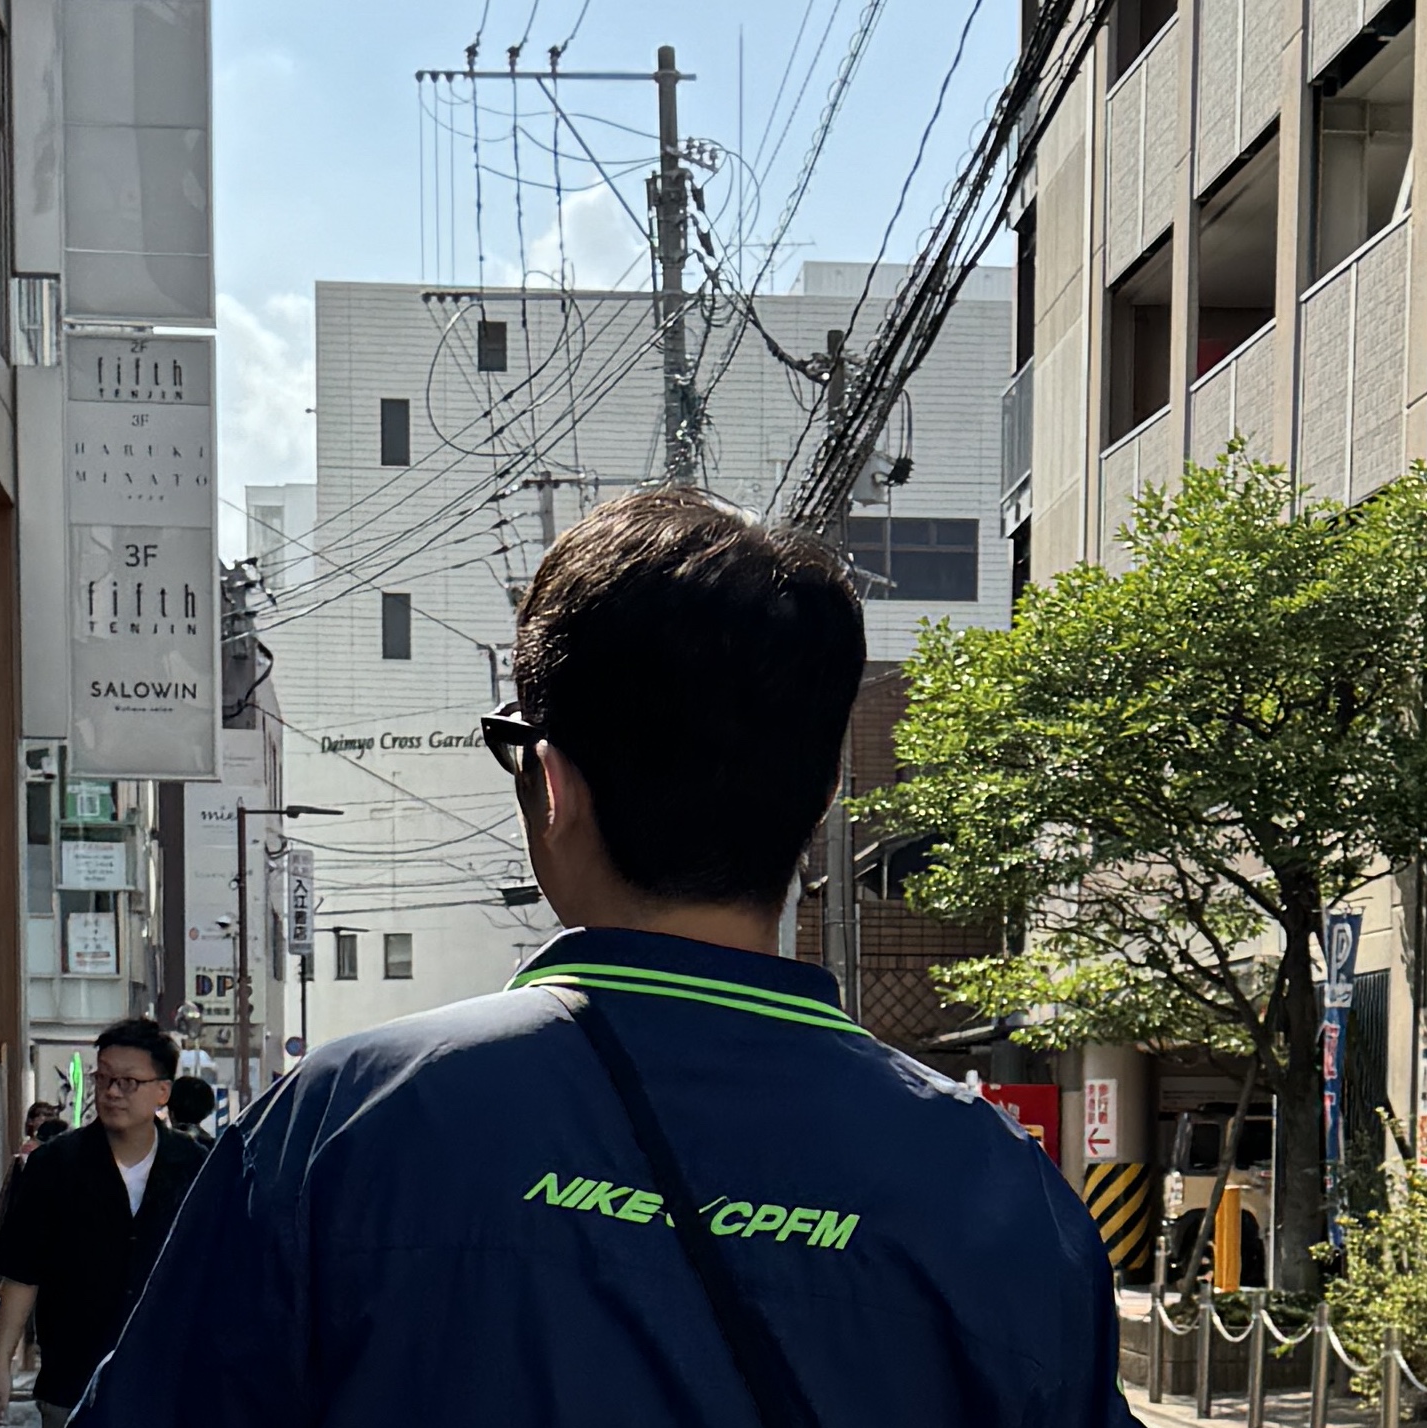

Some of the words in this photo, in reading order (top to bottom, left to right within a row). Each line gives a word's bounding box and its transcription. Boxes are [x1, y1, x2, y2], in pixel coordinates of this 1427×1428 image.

[97, 357, 183, 387] fifth
[131, 413, 150, 427] 3F
[125, 544, 159, 567] 3F
[88, 581, 196, 618] fifth
[89, 621, 197, 636] TENJIN
[90, 681, 197, 700] SALOWIN
[321, 734, 375, 760] Daimyo
[379, 732, 423, 750] Cross
[428, 727, 488, 749] Garde
[523, 1172, 665, 1224] NIKE
[710, 1201, 861, 1250] CPFM
